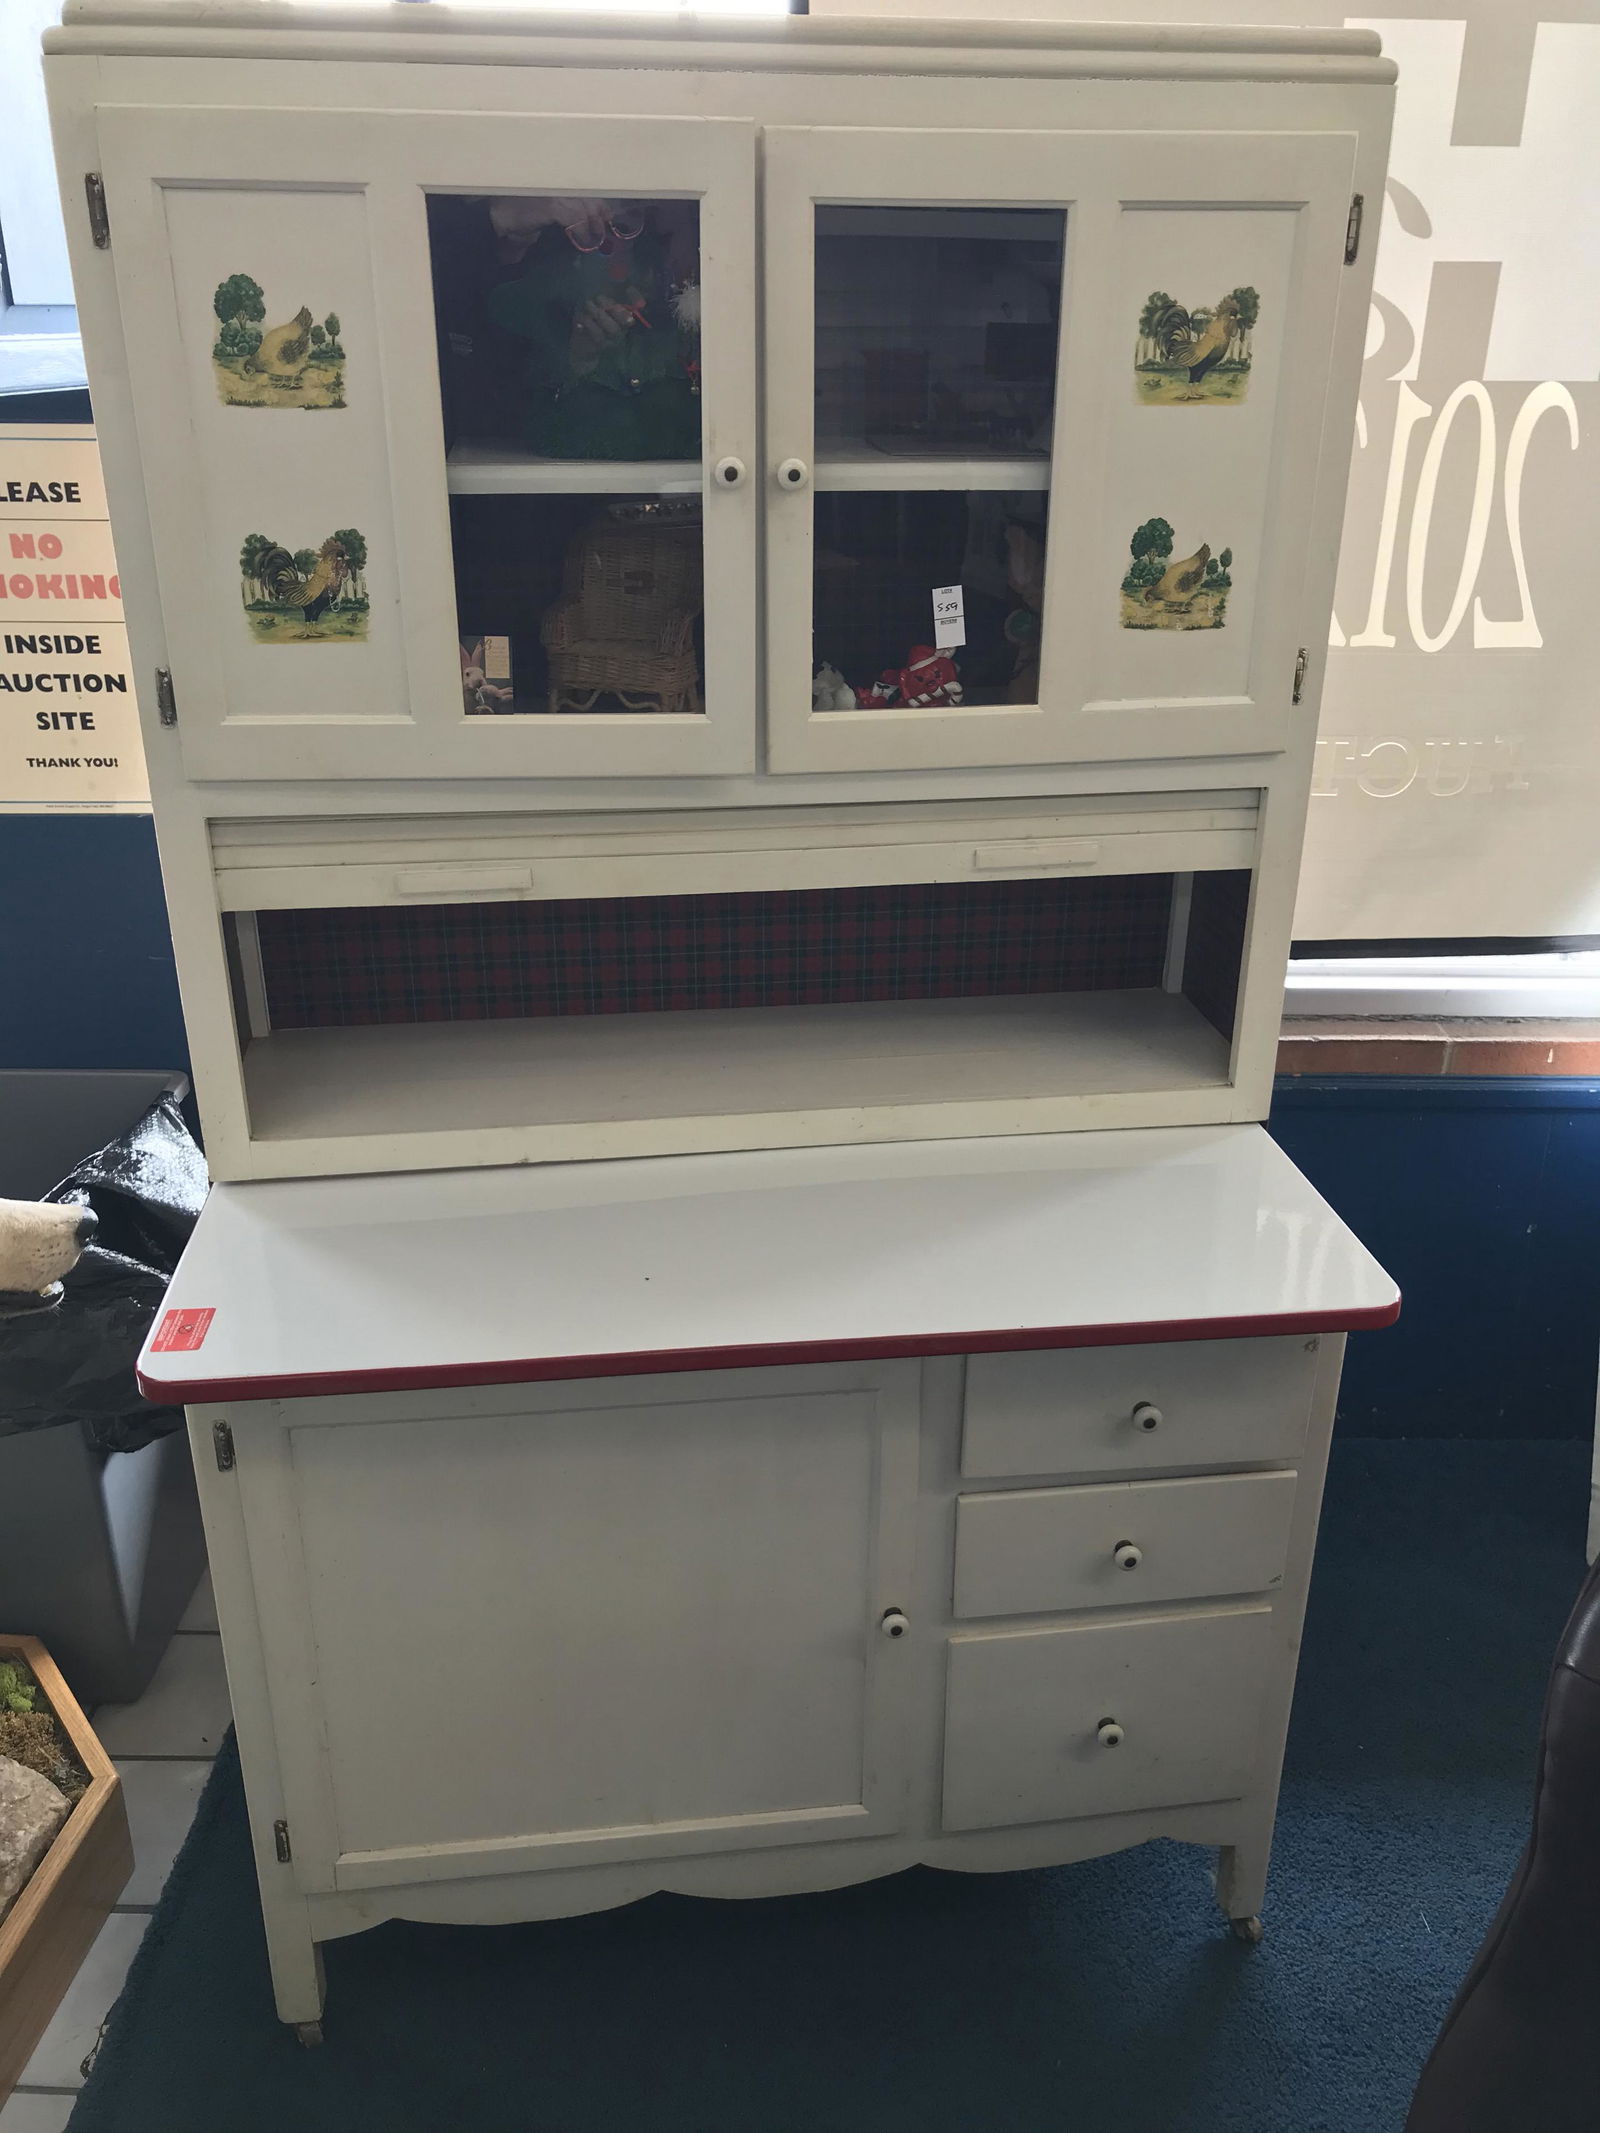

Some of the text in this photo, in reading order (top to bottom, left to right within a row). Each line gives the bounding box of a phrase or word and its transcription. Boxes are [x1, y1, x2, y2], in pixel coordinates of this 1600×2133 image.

[9, 533, 63, 559] NO
[0, 574, 121, 599] OKIN
[4, 635, 101, 654] INSIDE
[0, 674, 127, 692] AUCTION
[36, 712, 95, 730] SITE
[26, 758, 118, 767] THANK YOU!
